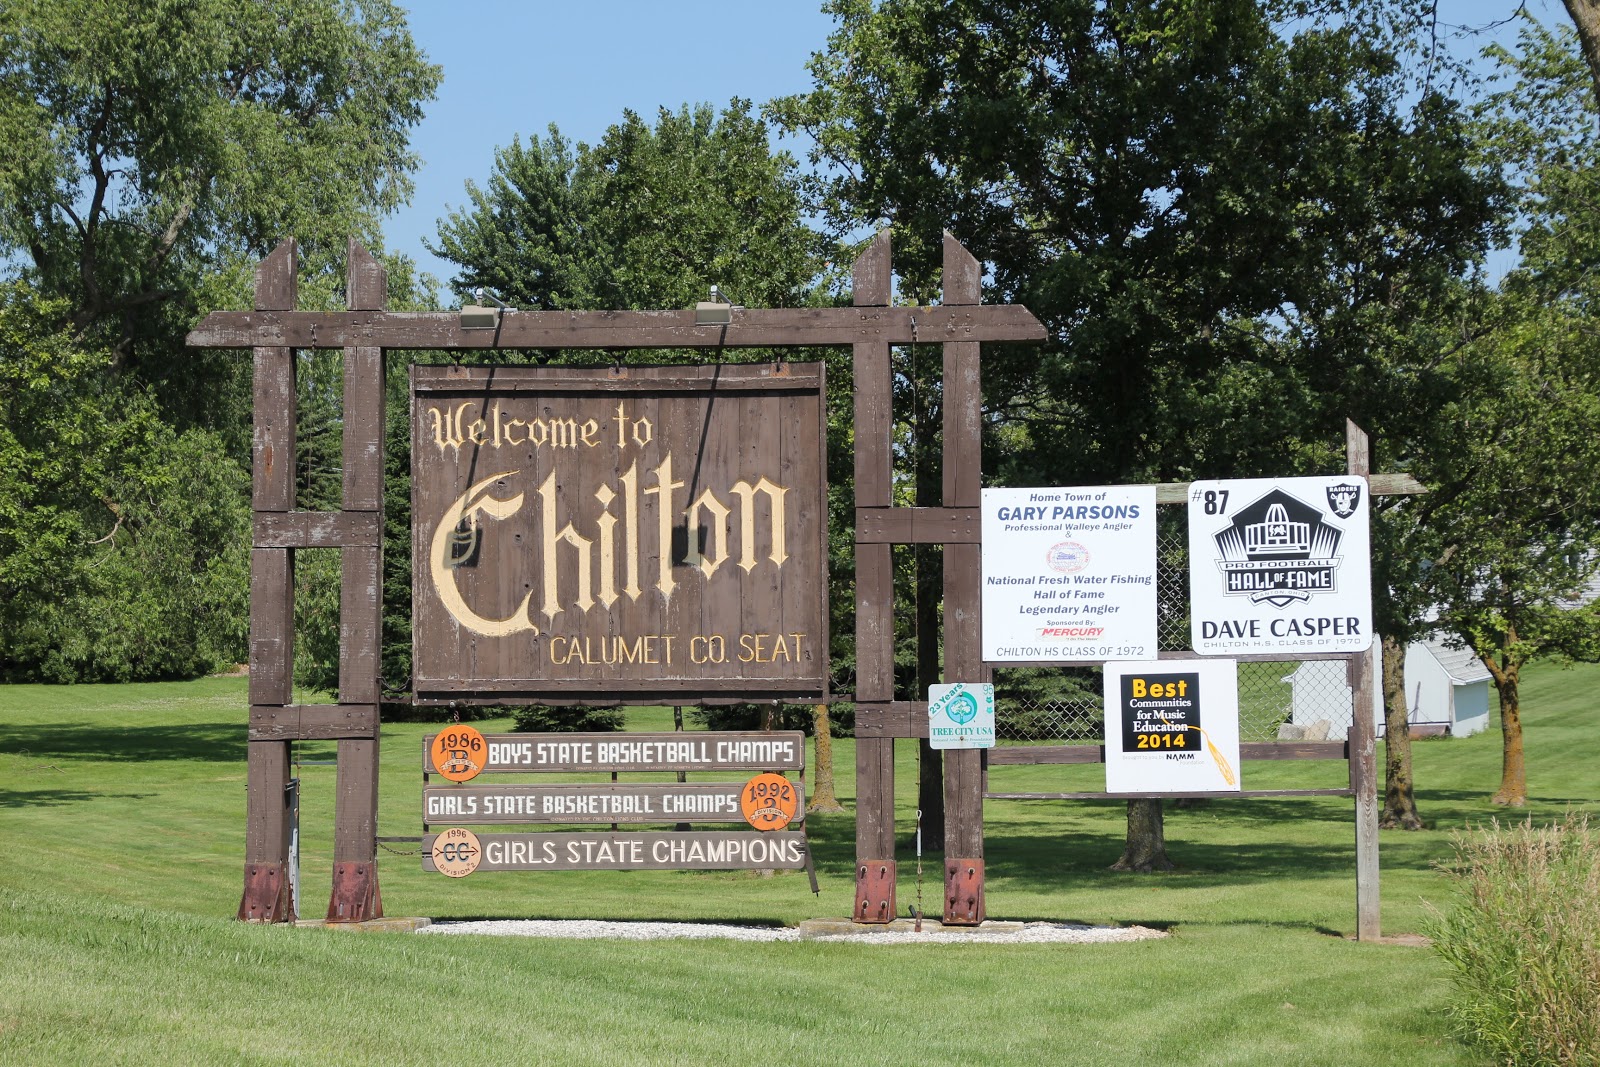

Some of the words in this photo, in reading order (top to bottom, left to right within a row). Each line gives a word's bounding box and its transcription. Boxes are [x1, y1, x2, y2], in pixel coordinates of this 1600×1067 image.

[428, 401, 601, 450] Welcome
[612, 400, 653, 449] to
[1030, 493, 1061, 502] Home
[1064, 493, 1091, 501] Town
[1094, 492, 1107, 501] of
[997, 506, 1048, 521] GARY
[1052, 505, 1140, 520] PARSONS
[1004, 523, 1062, 532] Professional
[1065, 523, 1100, 532] Walleye
[1102, 522, 1133, 532] Angler
[1065, 531, 1072, 539] &
[430, 450, 791, 637] Chilton
[1259, 560, 1334, 568] FOOTBALL
[987, 576, 1035, 586] National
[1038, 576, 1070, 585] Fresh
[1074, 575, 1107, 585] Water
[1110, 574, 1152, 586] Fishing
[1229, 572, 1275, 590] HALL
[1273, 572, 1285, 583] OF
[1285, 570, 1330, 588] FAME
[1033, 590, 1056, 599] Hall
[1059, 590, 1072, 599] of
[1074, 589, 1105, 599] Fame
[1019, 605, 1080, 616] Legendary
[1082, 604, 1120, 615] Angler
[1046, 619, 1084, 627] Sponsored
[1202, 619, 1261, 639] DAVE
[1270, 617, 1361, 637] CASPER
[1041, 627, 1105, 637] MERCURY
[550, 634, 676, 665] CALUMET
[690, 635, 730, 664] CO.
[737, 633, 807, 663] SEAT
[996, 647, 1042, 657] CHILTON
[1044, 647, 1060, 656] HS
[1062, 647, 1097, 656] CLASS
[1099, 646, 1114, 656] OF
[1116, 646, 1144, 656] 1972
[1132, 679, 1187, 697] Best
[930, 702, 942, 715] 23
[939, 683, 963, 703] Years
[1129, 698, 1192, 708] Communities
[1137, 710, 1152, 720] for
[1153, 710, 1186, 719] Music
[931, 727, 953, 735] TREE
[954, 727, 974, 735] CITY
[976, 727, 993, 735] USA
[1133, 721, 1189, 732] Education
[440, 733, 481, 753] 1986
[1137, 734, 1186, 748] 2014
[488, 743, 532, 764] BOYS
[537, 743, 593, 764] STATE
[597, 742, 712, 764] BASKETBALL
[716, 740, 794, 763] CHAMPS
[1166, 753, 1195, 761] NAMM
[749, 782, 790, 802] 1992
[428, 796, 477, 815] GIRLS
[483, 796, 536, 814] STATE
[542, 795, 652, 814] BASKETBALL
[662, 794, 738, 813] CHAMPS
[447, 829, 467, 839] 1996
[443, 842, 469, 862] CC
[486, 842, 556, 864] GIRLS
[566, 841, 643, 863] STATE
[652, 839, 802, 863] CHAMPIONS
[439, 863, 471, 876] DIVISION
